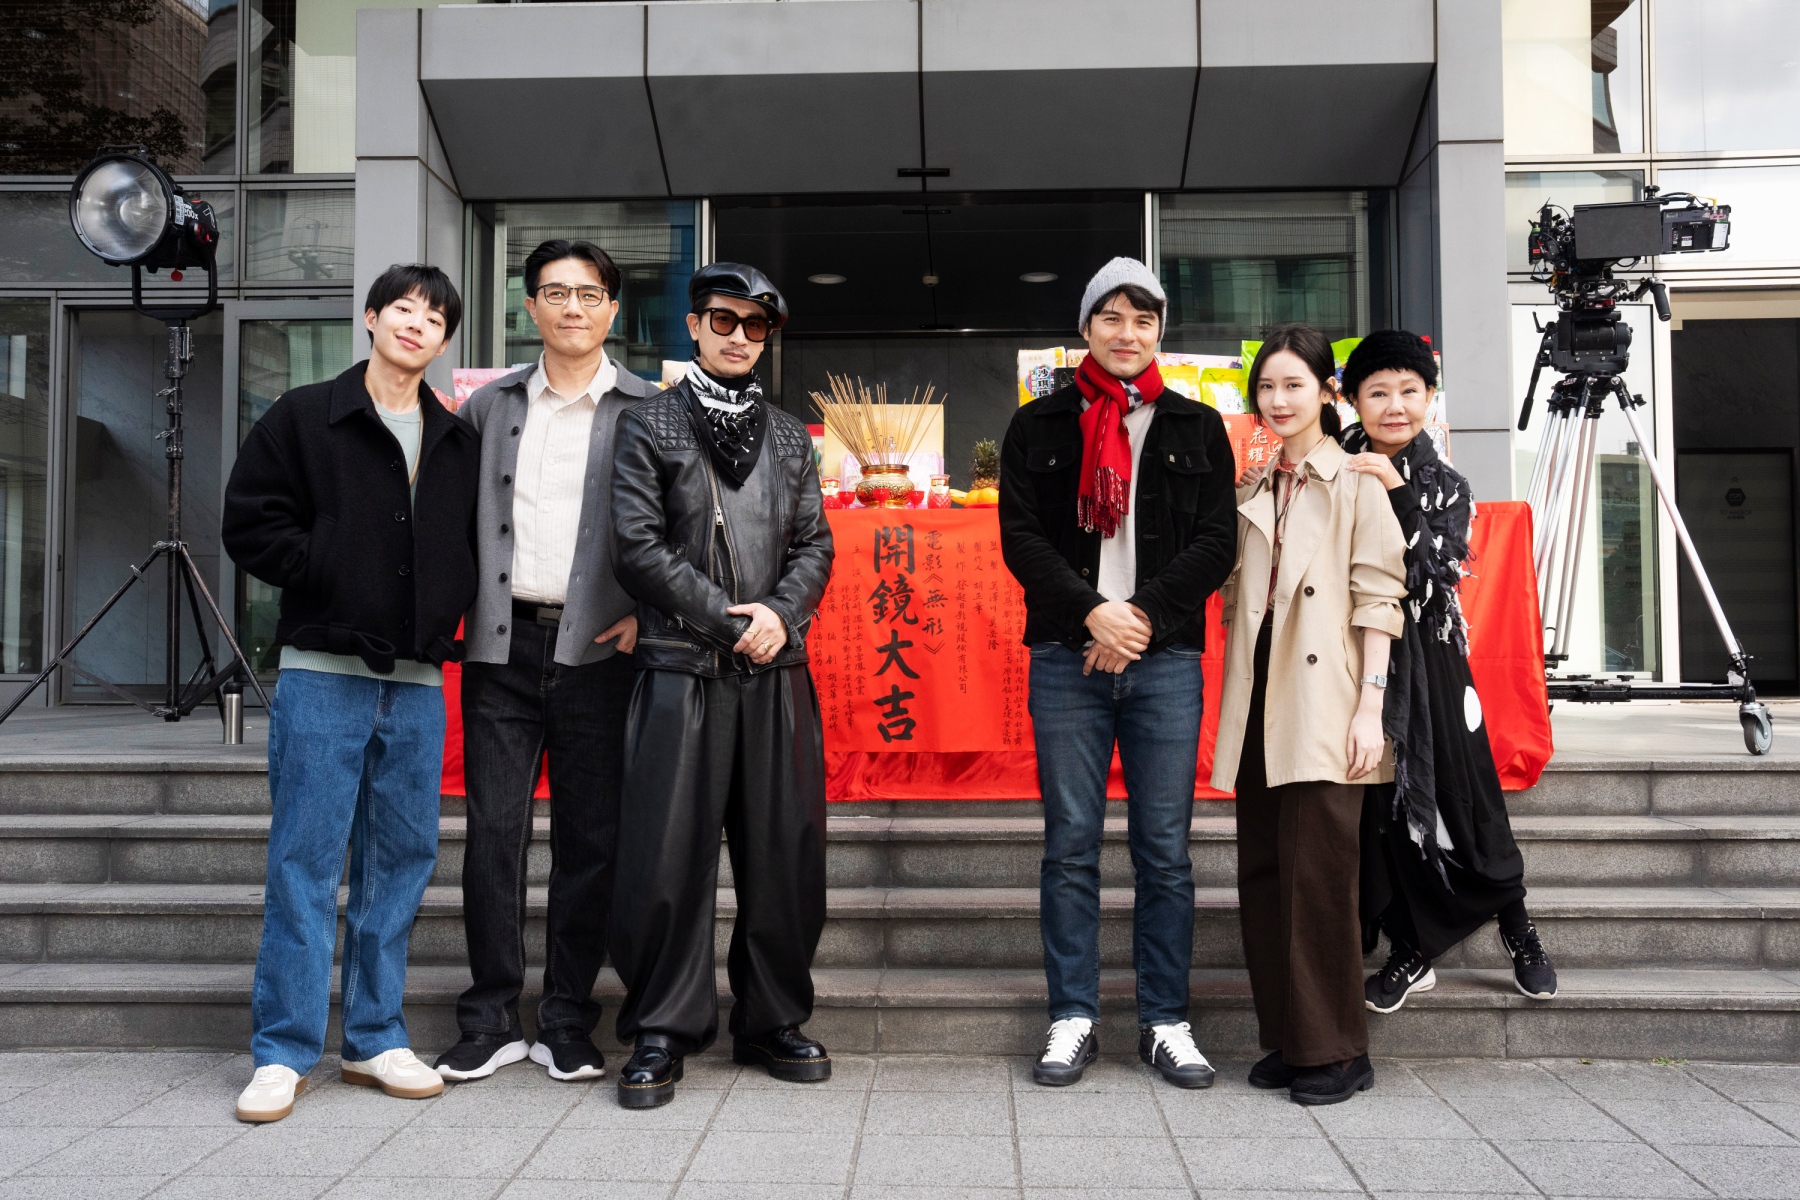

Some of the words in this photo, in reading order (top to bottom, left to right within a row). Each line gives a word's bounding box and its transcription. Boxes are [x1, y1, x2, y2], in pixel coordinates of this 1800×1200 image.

[922, 530, 948, 655] 電影《無形》
[956, 541, 966, 572] 製作
[973, 541, 983, 571] 製作人
[866, 523, 921, 744] 開鏡大吉
[955, 579, 969, 694] 發起日影視股份有限公司
